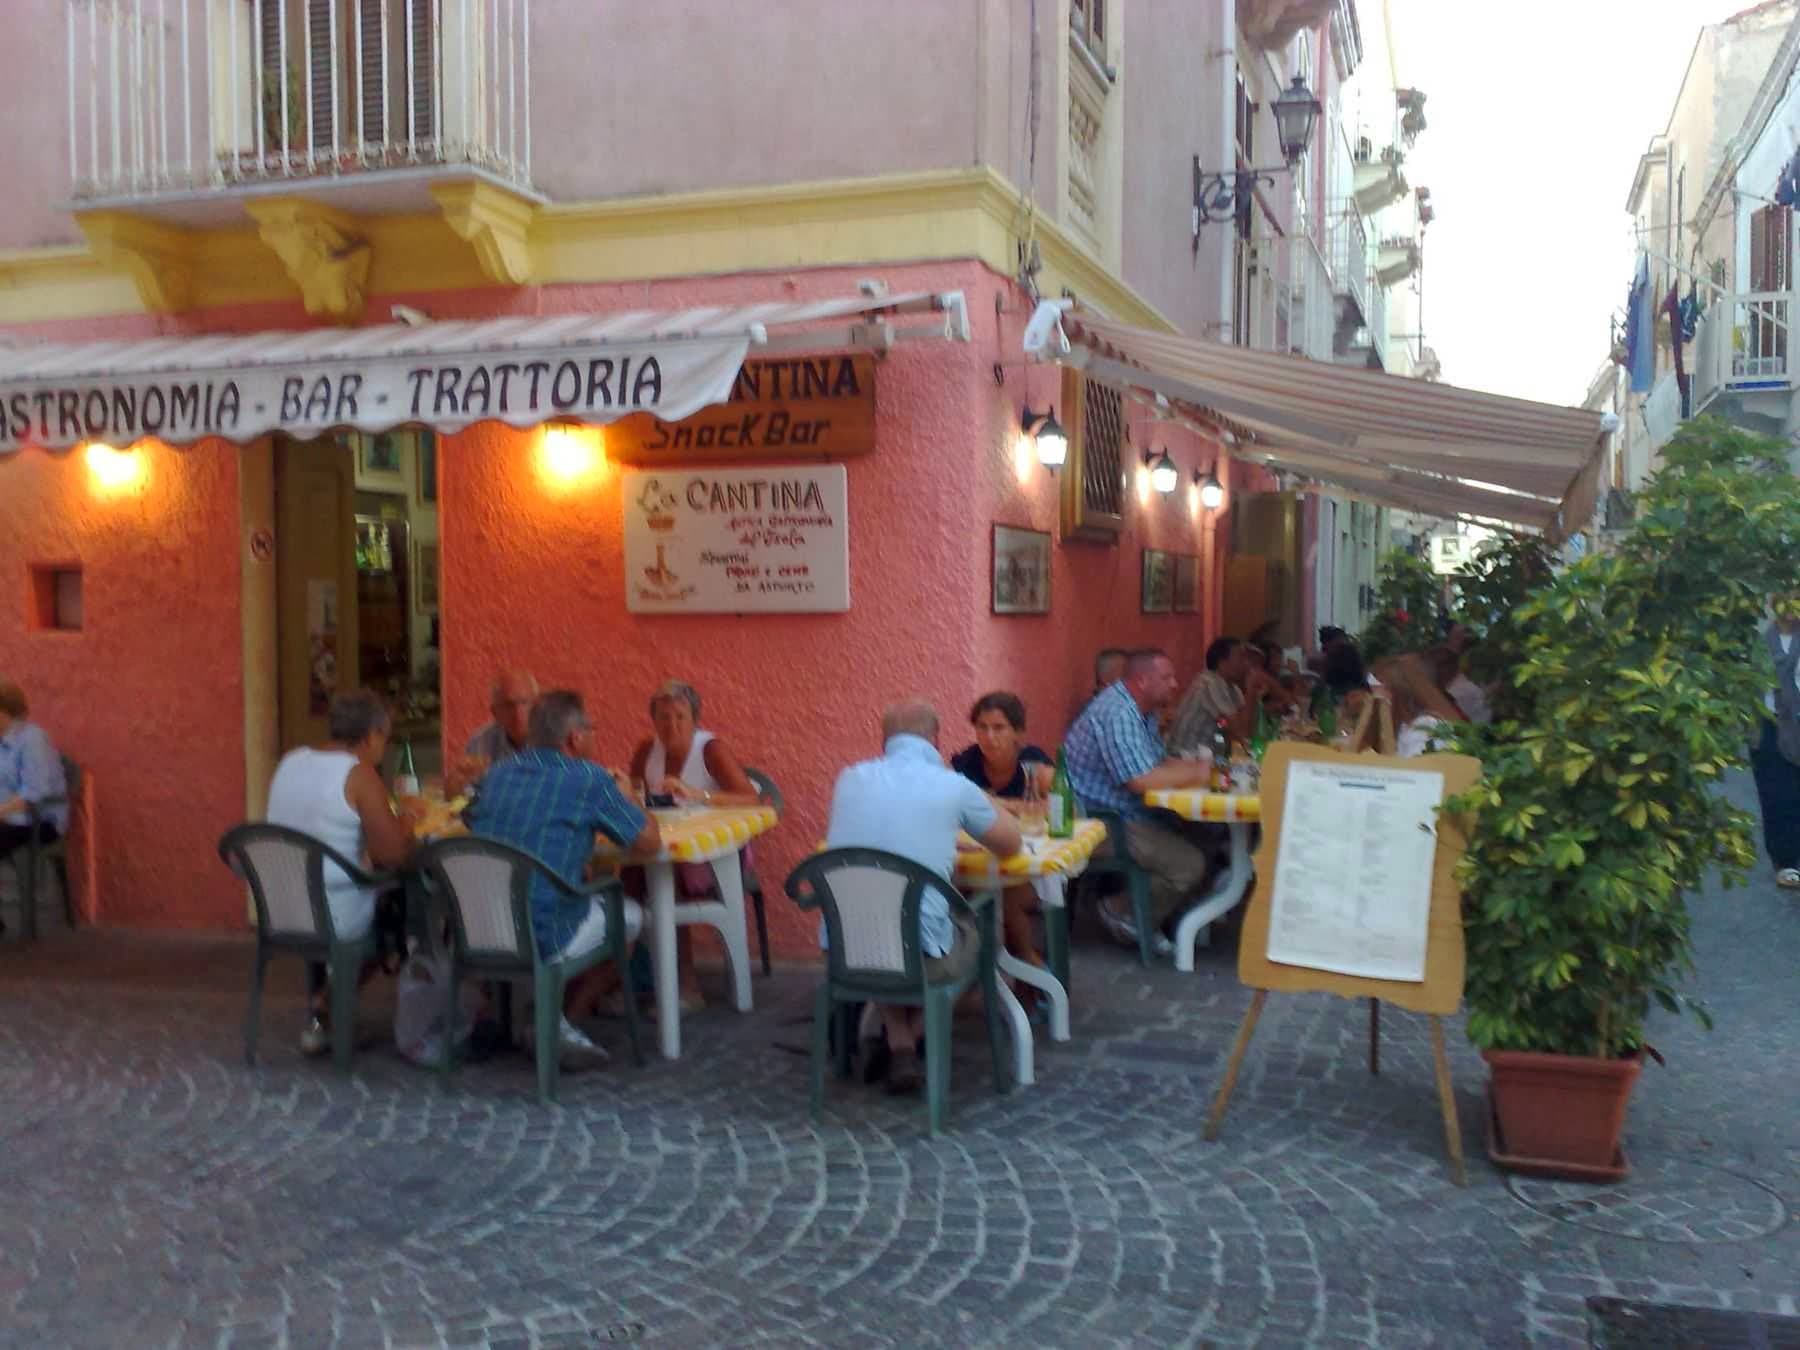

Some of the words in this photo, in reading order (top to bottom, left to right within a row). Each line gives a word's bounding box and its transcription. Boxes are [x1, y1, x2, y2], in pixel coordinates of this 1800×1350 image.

[0, 378, 241, 441] STRONOMIA
[280, 373, 362, 425] BAR
[407, 356, 662, 415] TRATTORIA
[729, 358, 861, 401] NTINA
[645, 412, 764, 449] Snack
[763, 411, 833, 446] Bar
[686, 477, 825, 513] CANTINA
